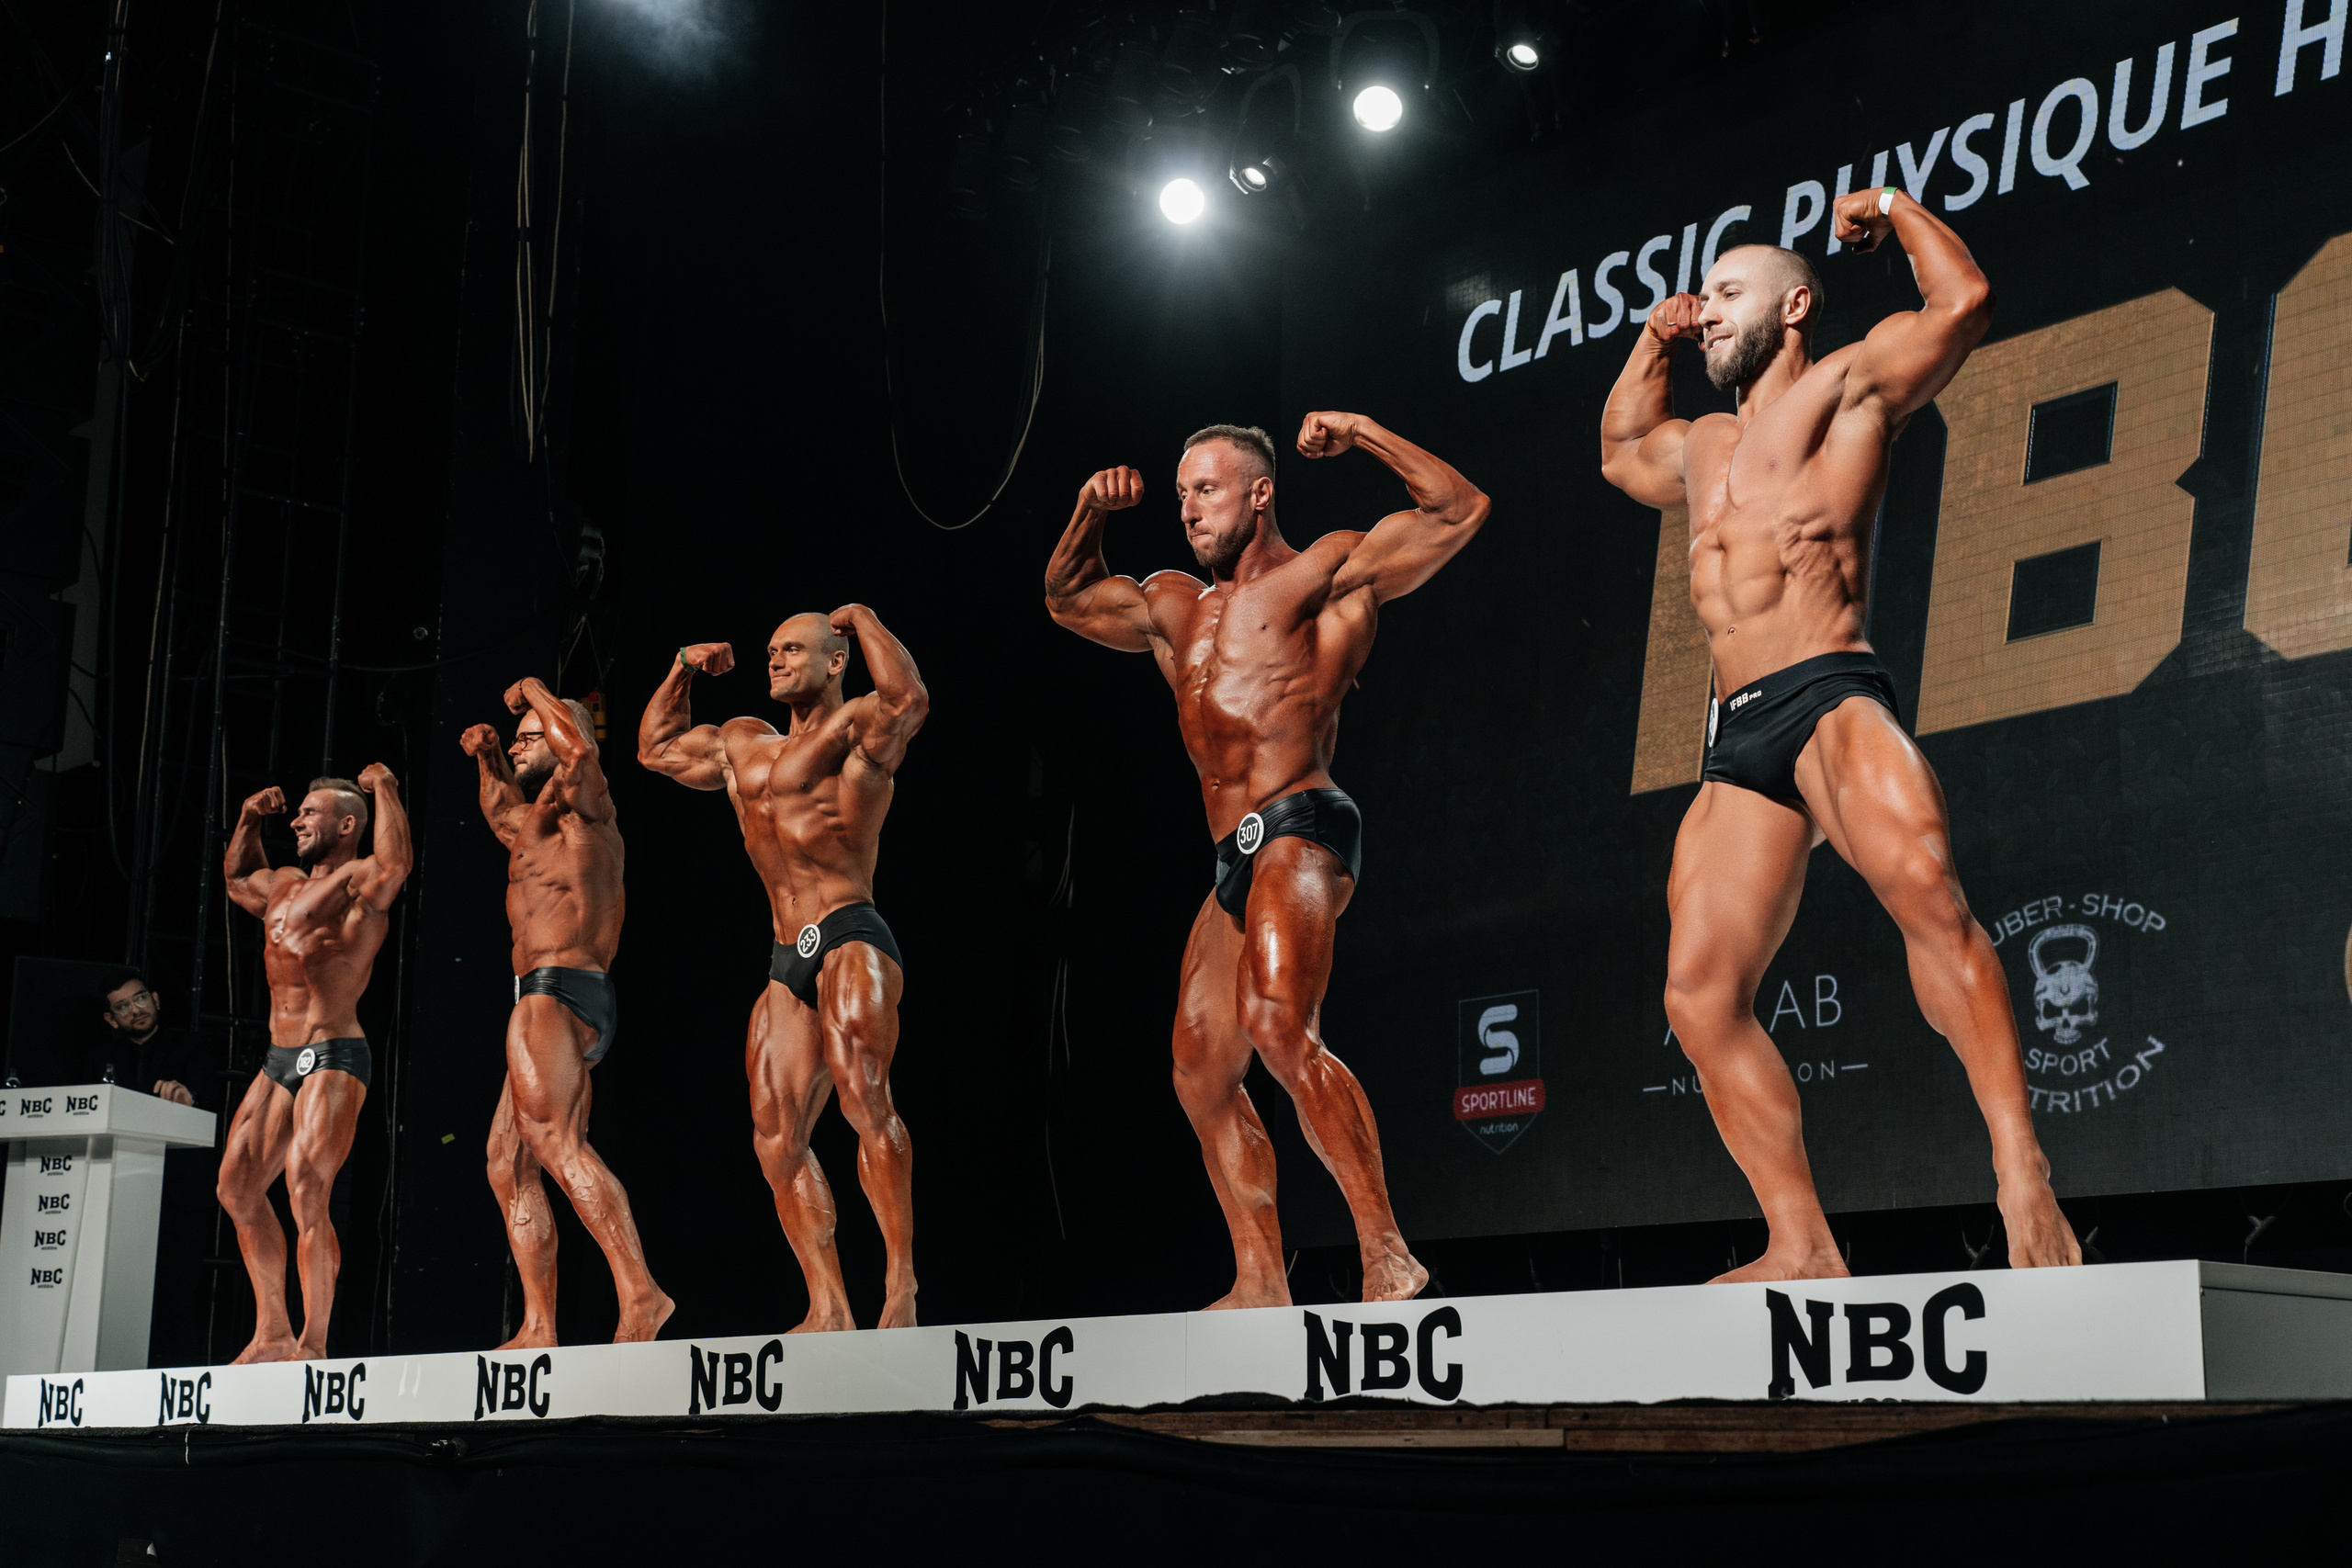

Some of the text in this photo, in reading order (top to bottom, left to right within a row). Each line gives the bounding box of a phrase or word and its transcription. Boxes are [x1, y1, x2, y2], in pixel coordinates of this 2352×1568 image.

[1730, 691, 1762, 711] IFBB PRO
[1240, 822, 1258, 844] 307
[2025, 1037, 2111, 1077] SPORT
[20, 1098, 52, 1116] NBC
[66, 1095, 98, 1113] NBC
[1461, 1088, 1536, 1113] SPORTLINE
[1479, 1122, 1519, 1134] nutrition
[40, 1155, 72, 1173] NBC
[38, 1193, 70, 1212] NBC
[34, 1230, 66, 1247] NBC
[30, 1268, 62, 1286] NBC
[1303, 1304, 1464, 1402] NBC
[1766, 1281, 1988, 1400] NBC
[689, 1337, 784, 1415] NBC
[953, 1325, 1075, 1410] NBC
[159, 1371, 211, 1424] NBC
[302, 1361, 367, 1422] NBC
[475, 1352, 551, 1420] NBC
[39, 1378, 84, 1427] NBC
